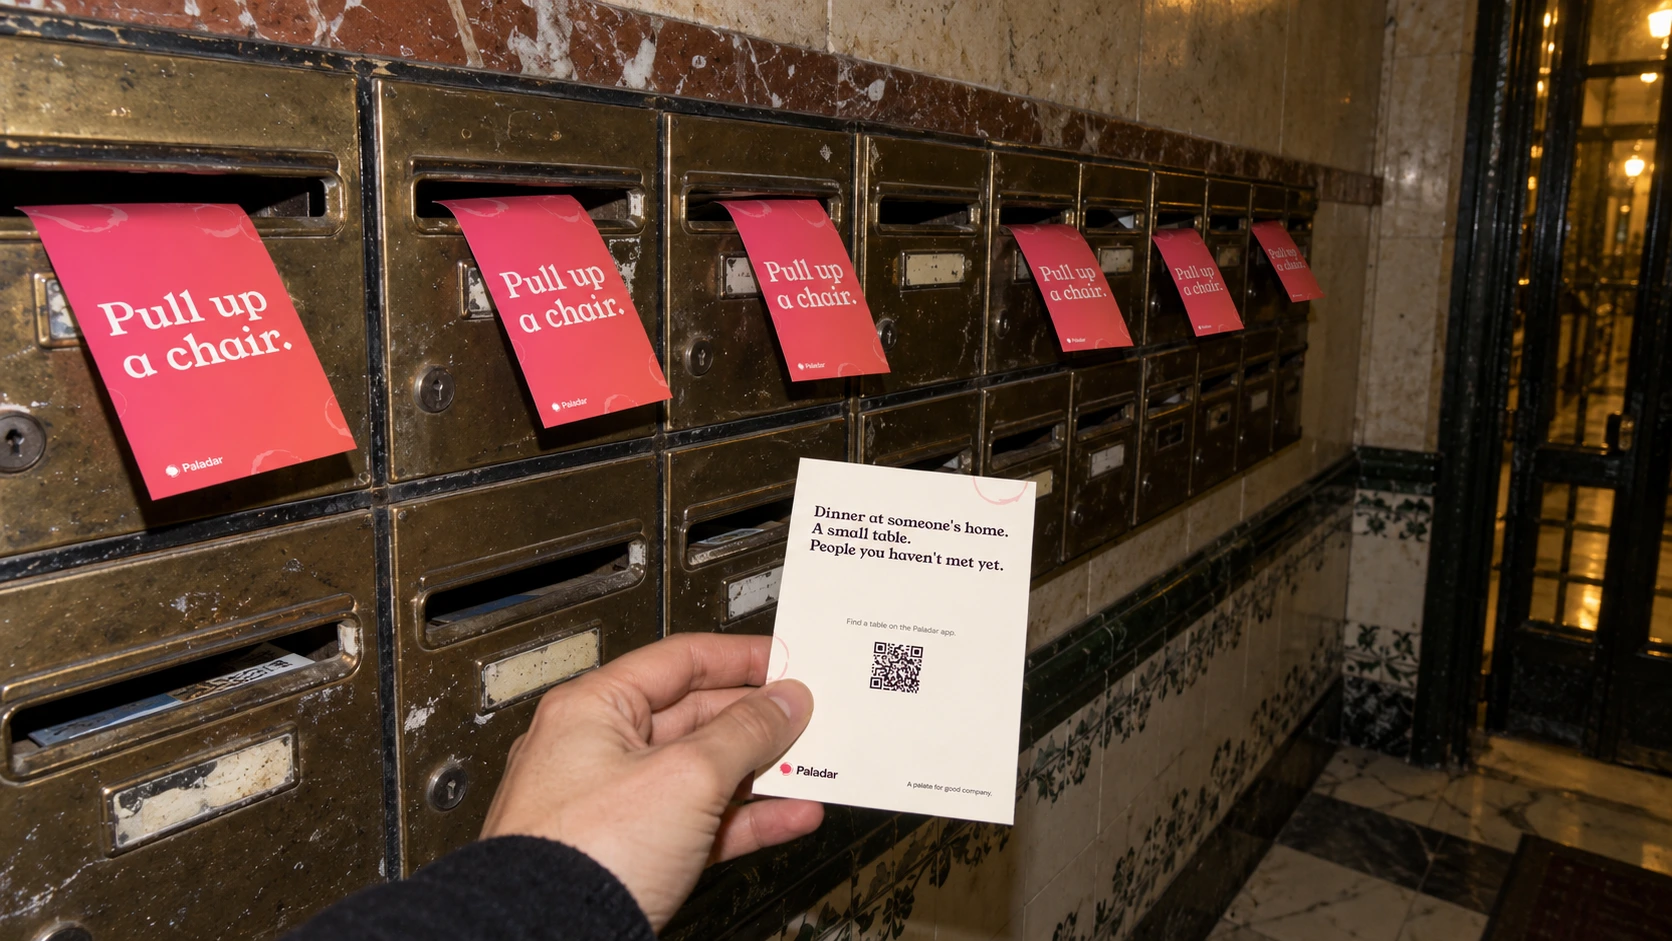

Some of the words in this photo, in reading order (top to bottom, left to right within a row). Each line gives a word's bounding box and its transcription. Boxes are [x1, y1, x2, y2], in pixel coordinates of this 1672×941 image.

[499, 264, 567, 298] Pull
[567, 265, 605, 291] up
[764, 259, 814, 283] Pull
[814, 263, 843, 284] up
[1038, 264, 1075, 282] Pull
[1075, 267, 1096, 281] up
[1175, 265, 1199, 280] Pull
[1200, 267, 1214, 279] up
[777, 295, 793, 309] a
[797, 286, 857, 308] chair.
[1050, 290, 1062, 301] a
[1064, 283, 1107, 300] chair.
[1184, 286, 1192, 296] a
[1193, 280, 1223, 294] chair.
[97, 289, 205, 336] Pull
[209, 290, 267, 321] up
[519, 313, 541, 333] a
[545, 294, 625, 328] chair.
[123, 354, 158, 378] a
[166, 326, 292, 370] chair.
[561, 398, 587, 409] Paladar
[182, 455, 223, 472] Paladar
[814, 505, 866, 522] Dinner
[869, 514, 884, 524] at
[887, 516, 961, 532] someone's
[965, 522, 1009, 537] home.
[812, 523, 824, 535] A
[827, 527, 868, 539] small
[873, 531, 911, 544] table.
[810, 539, 856, 556] People
[860, 547, 884, 559] you
[888, 547, 942, 564] haven't
[946, 555, 974, 568] met
[978, 560, 1004, 571] yet.
[846, 618, 862, 626] Find
[870, 620, 887, 628] table
[900, 623, 911, 631] the
[913, 625, 939, 634] Paladar
[940, 629, 956, 637] app.
[796, 765, 838, 780] Paladar
[962, 788, 992, 797] company.
